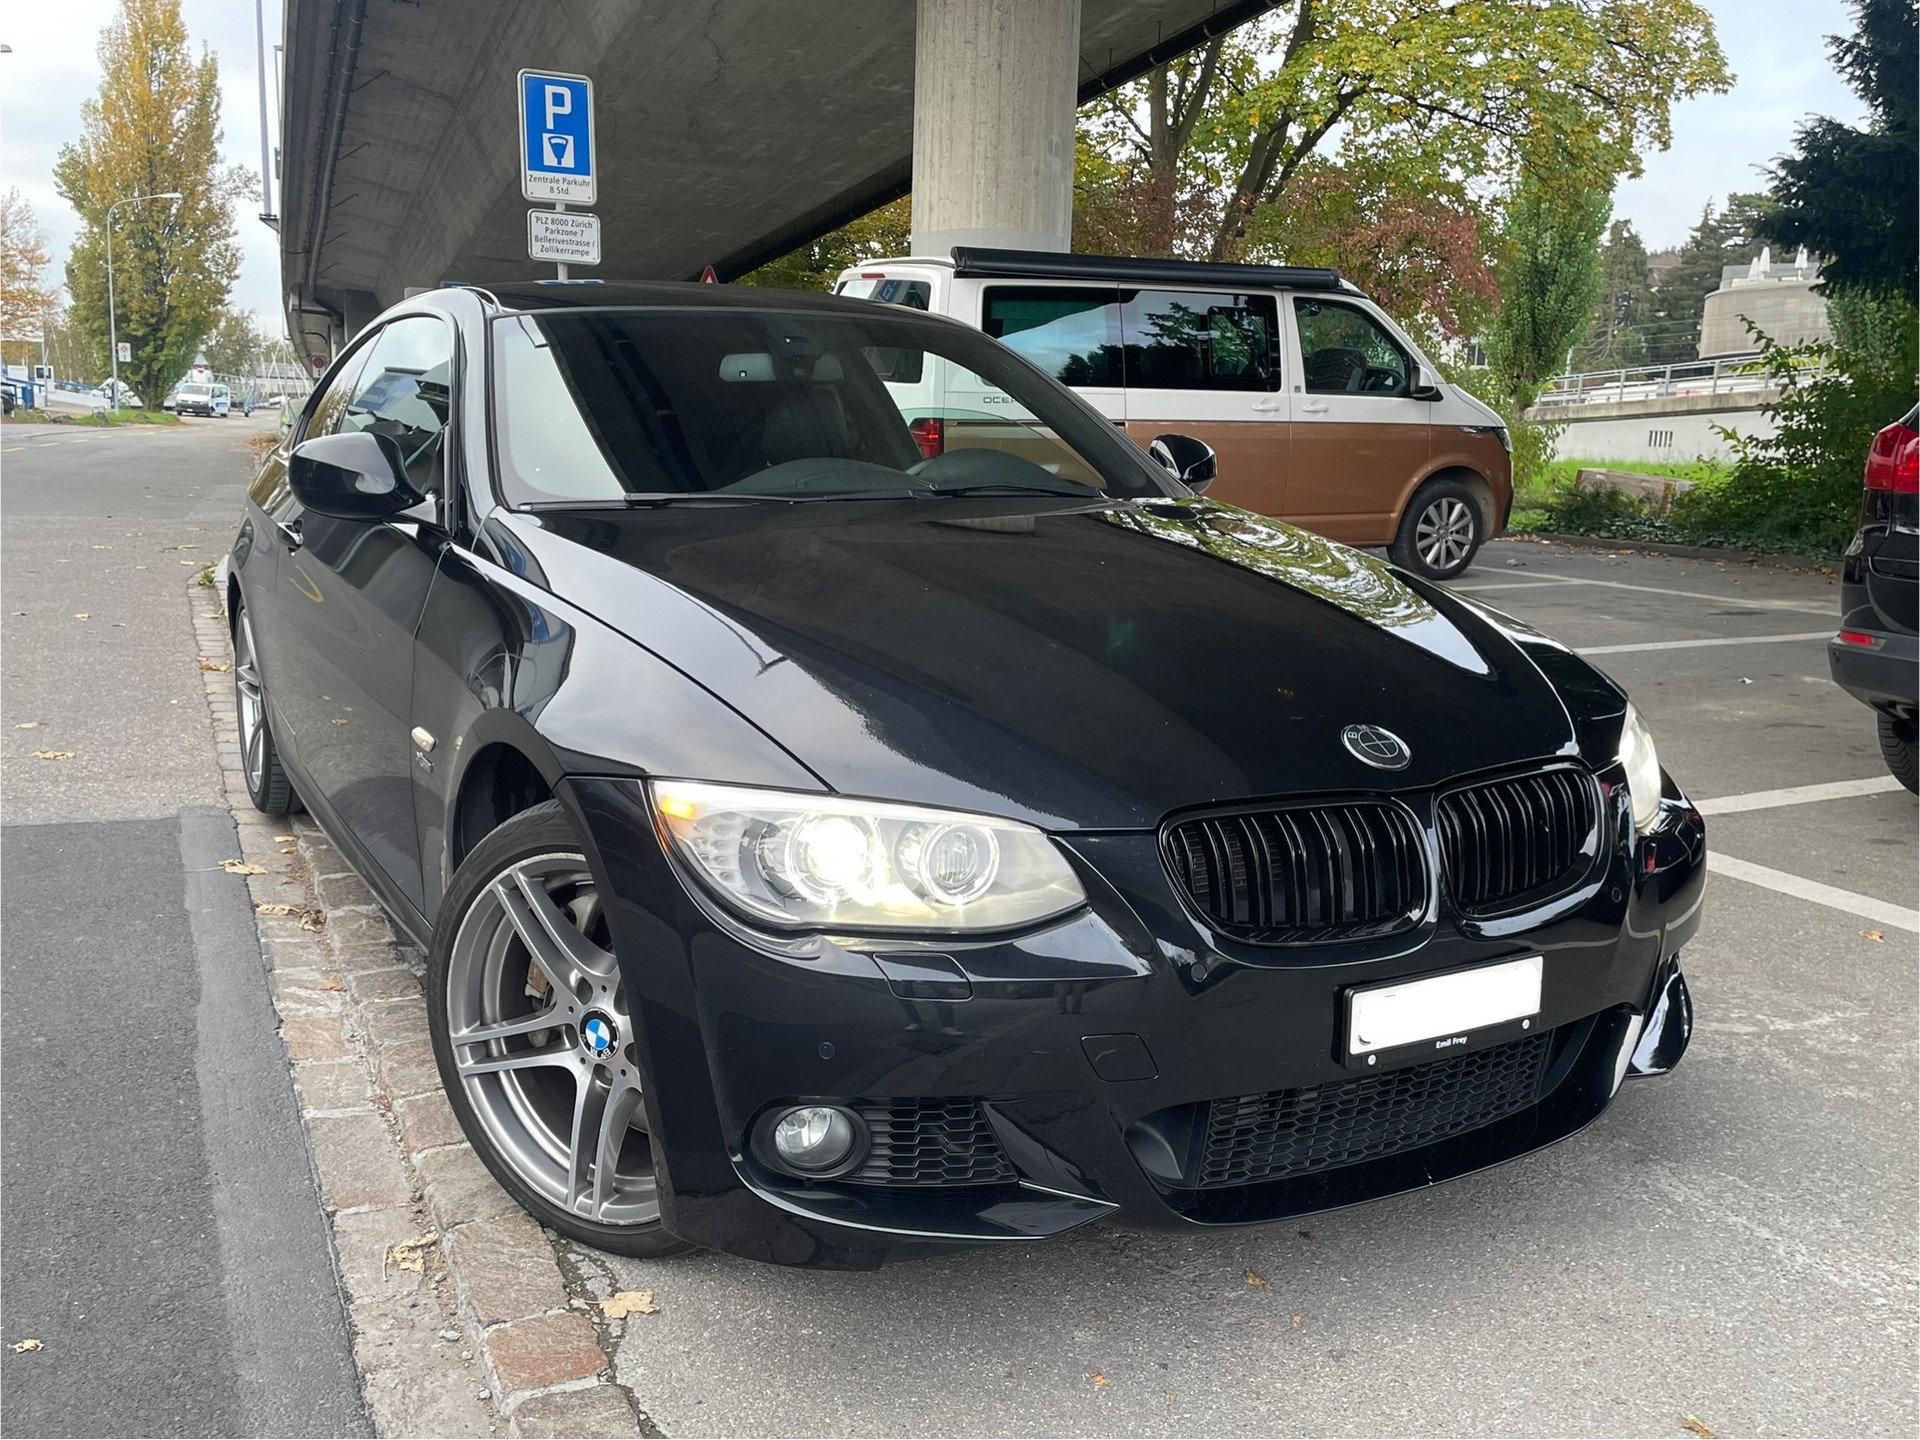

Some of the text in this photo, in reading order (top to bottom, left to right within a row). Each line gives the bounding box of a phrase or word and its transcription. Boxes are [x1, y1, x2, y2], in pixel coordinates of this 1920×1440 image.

[545, 84, 572, 130] P
[528, 174, 591, 187] Zentrale Parkuhr
[549, 186, 571, 195] 8 Std.
[535, 215, 593, 229] PLZ 8000 Zürich
[545, 226, 585, 238] Parkzone 7
[534, 235, 590, 247] Bellerivestrasse
[540, 244, 590, 257] Zollikerrampe
[1435, 1036, 1468, 1049] Emil Frey
